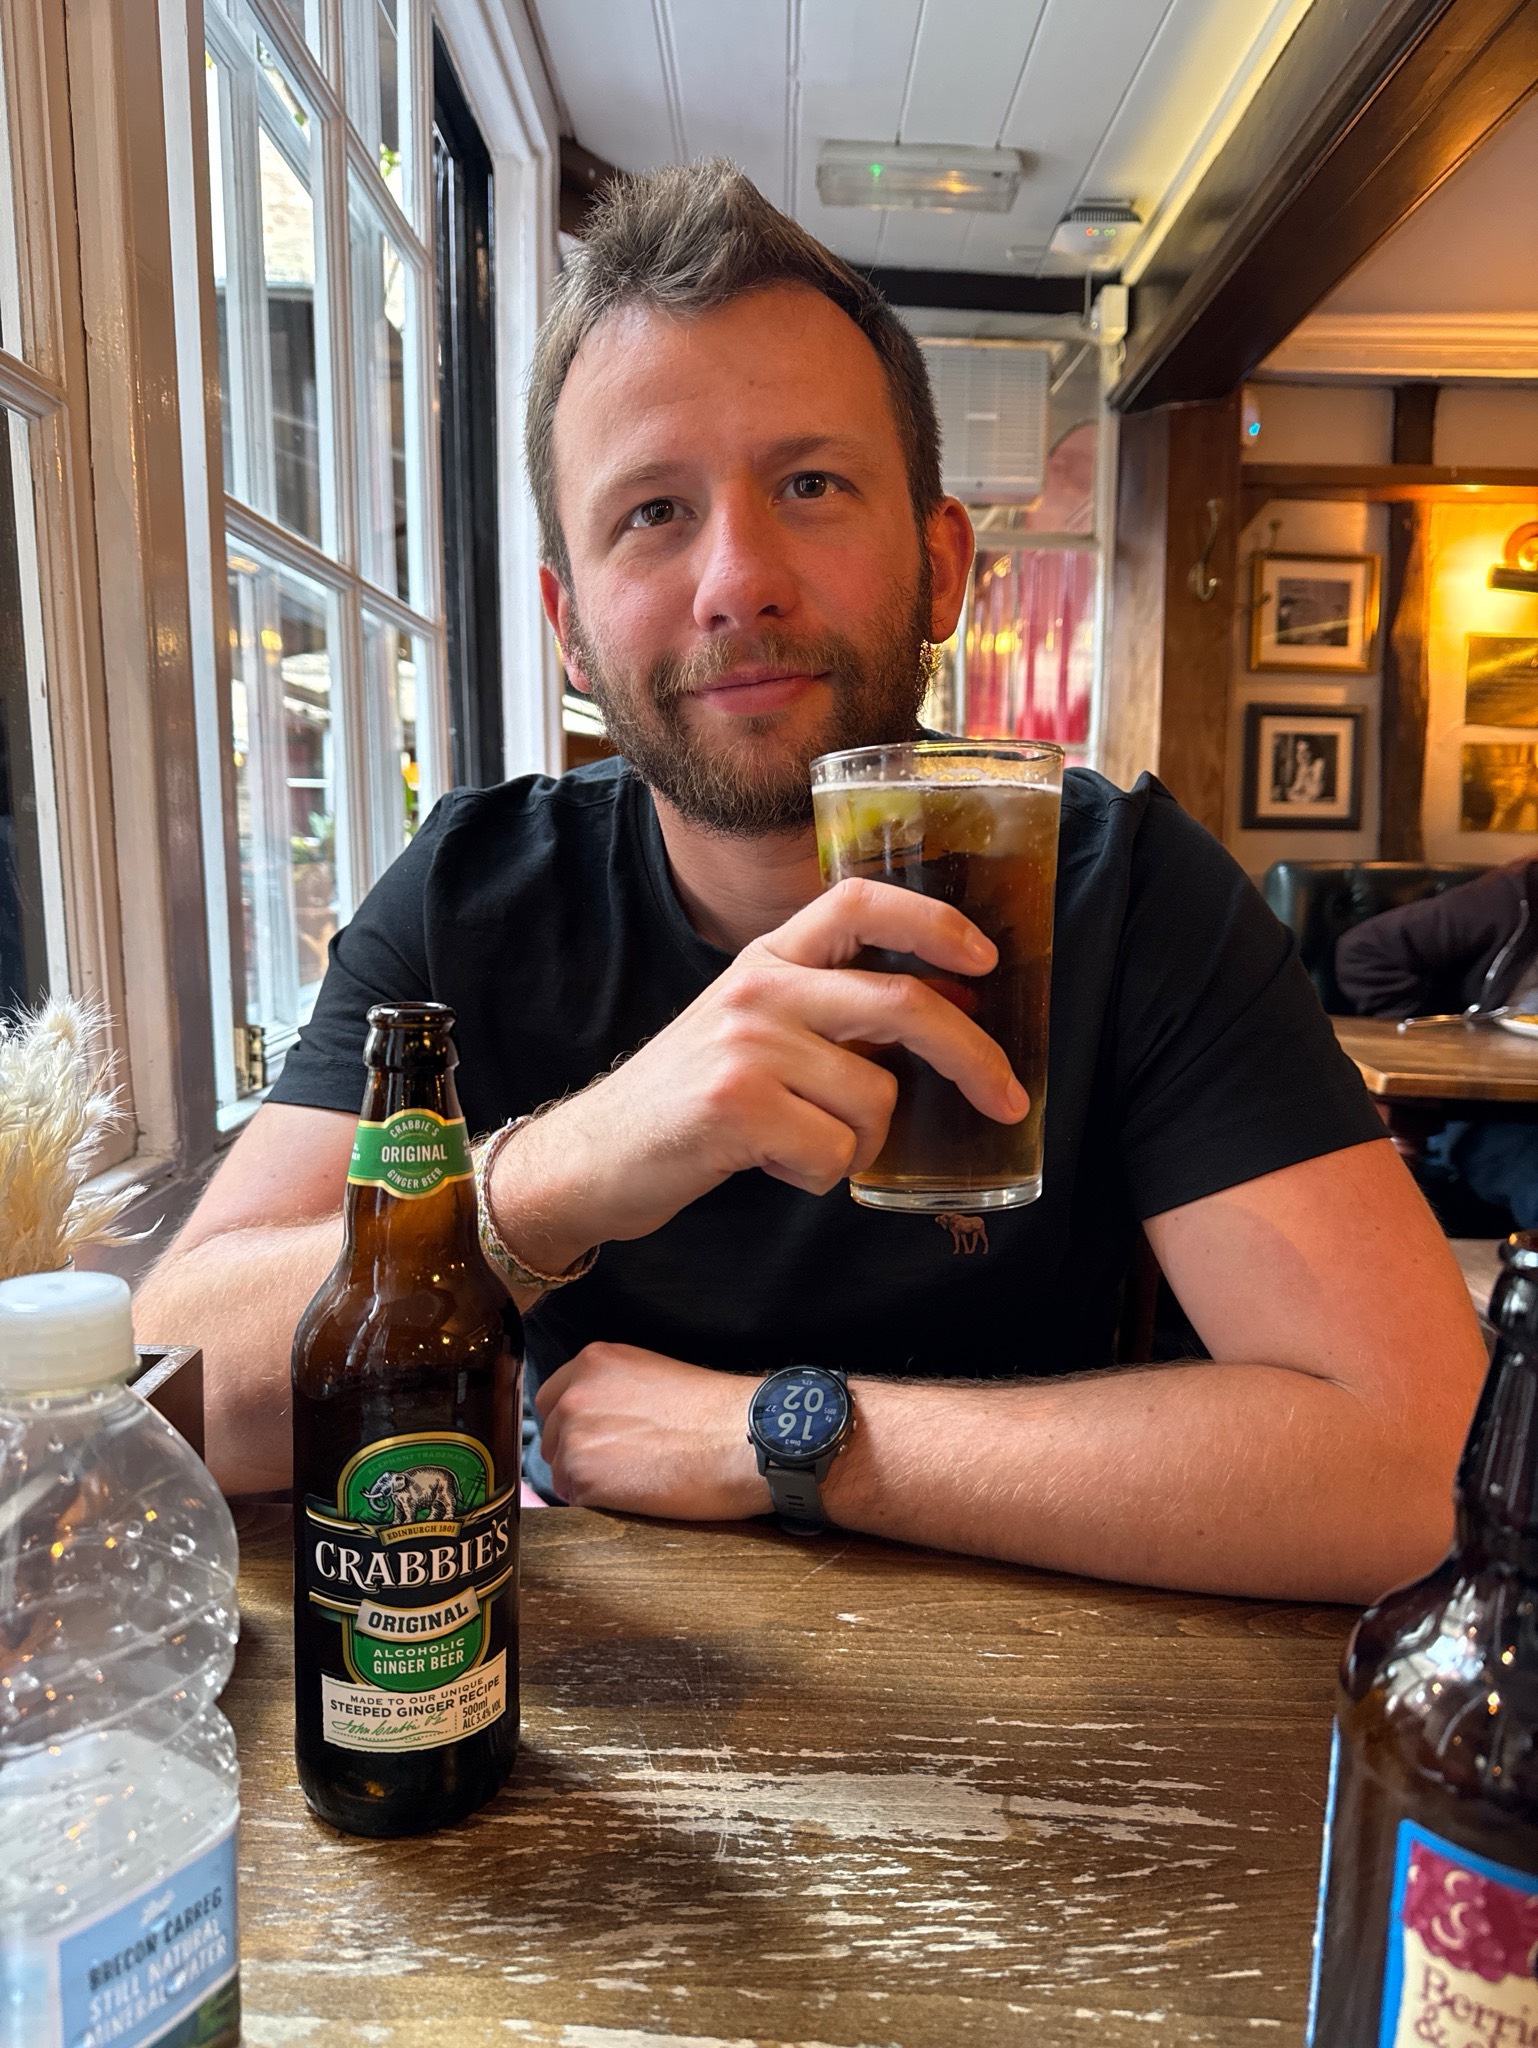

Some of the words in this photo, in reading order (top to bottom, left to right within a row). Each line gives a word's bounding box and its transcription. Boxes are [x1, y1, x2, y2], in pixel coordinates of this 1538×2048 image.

[389, 1119, 440, 1138] CRABBIE'S
[381, 1143, 448, 1163] ORIGINAL
[386, 1169, 419, 1189] GINGER
[421, 1167, 443, 1186] BEER
[783, 1385, 825, 1413] 02
[777, 1412, 813, 1440] 16
[368, 1455, 414, 1474] ELEPHANT
[386, 1525, 437, 1540] EDINBURGH
[439, 1525, 456, 1534] 1801
[315, 1518, 510, 1592] CRABBIE'S
[368, 1603, 470, 1634] ORIGINAL
[373, 1637, 466, 1658] ALCOHOLIC
[373, 1659, 425, 1675] GINGER
[430, 1650, 465, 1670] BEER
[330, 1699, 392, 1718] STEEPED
[397, 1700, 455, 1718] GINGER
[459, 1675, 500, 1706] RECIPE
[350, 1694, 383, 1706] MADE
[387, 1698, 405, 1706] TO
[409, 1694, 436, 1704] OUR
[441, 1677, 484, 1698] UNIQUE
[462, 1696, 488, 1718] 500ml
[163, 1886, 224, 1944] CARREG
[166, 1934, 228, 1995] ATER
